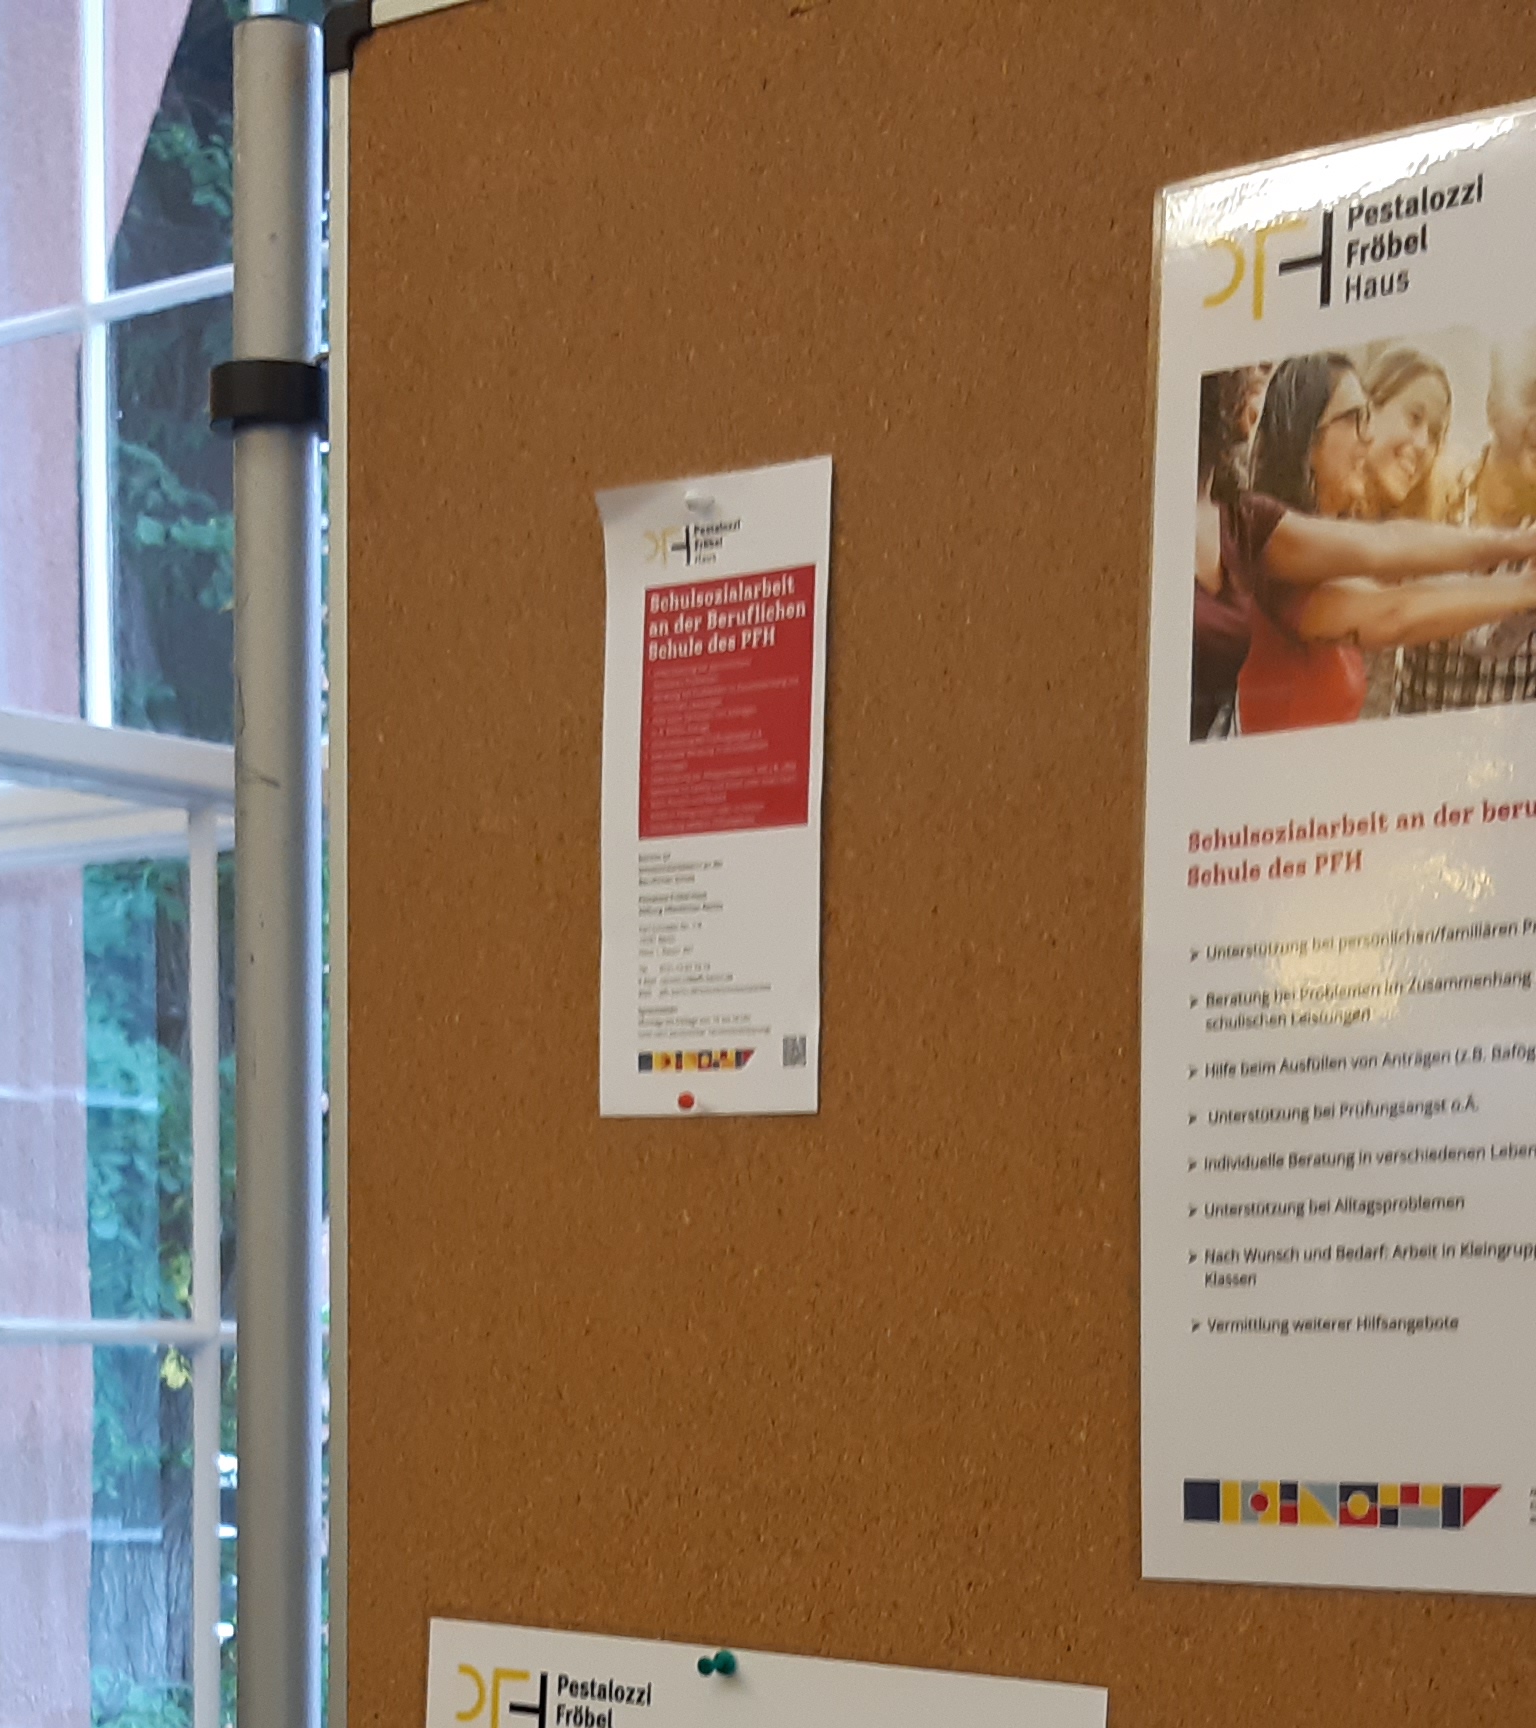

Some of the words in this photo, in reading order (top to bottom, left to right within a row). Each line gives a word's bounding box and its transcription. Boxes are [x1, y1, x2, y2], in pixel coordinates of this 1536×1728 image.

[1346, 172, 1483, 232] Pestalozzi
[1345, 222, 1427, 269] Fröbel
[1344, 269, 1410, 304] Haus
[1187, 810, 1388, 852] Schulsozialarbeit
[1395, 811, 1425, 830] an
[1432, 802, 1474, 827] der
[1186, 859, 1261, 887] Schule
[1267, 855, 1307, 879] des
[1314, 848, 1362, 875] PFH
[556, 1673, 652, 1706] Pestalozzi
